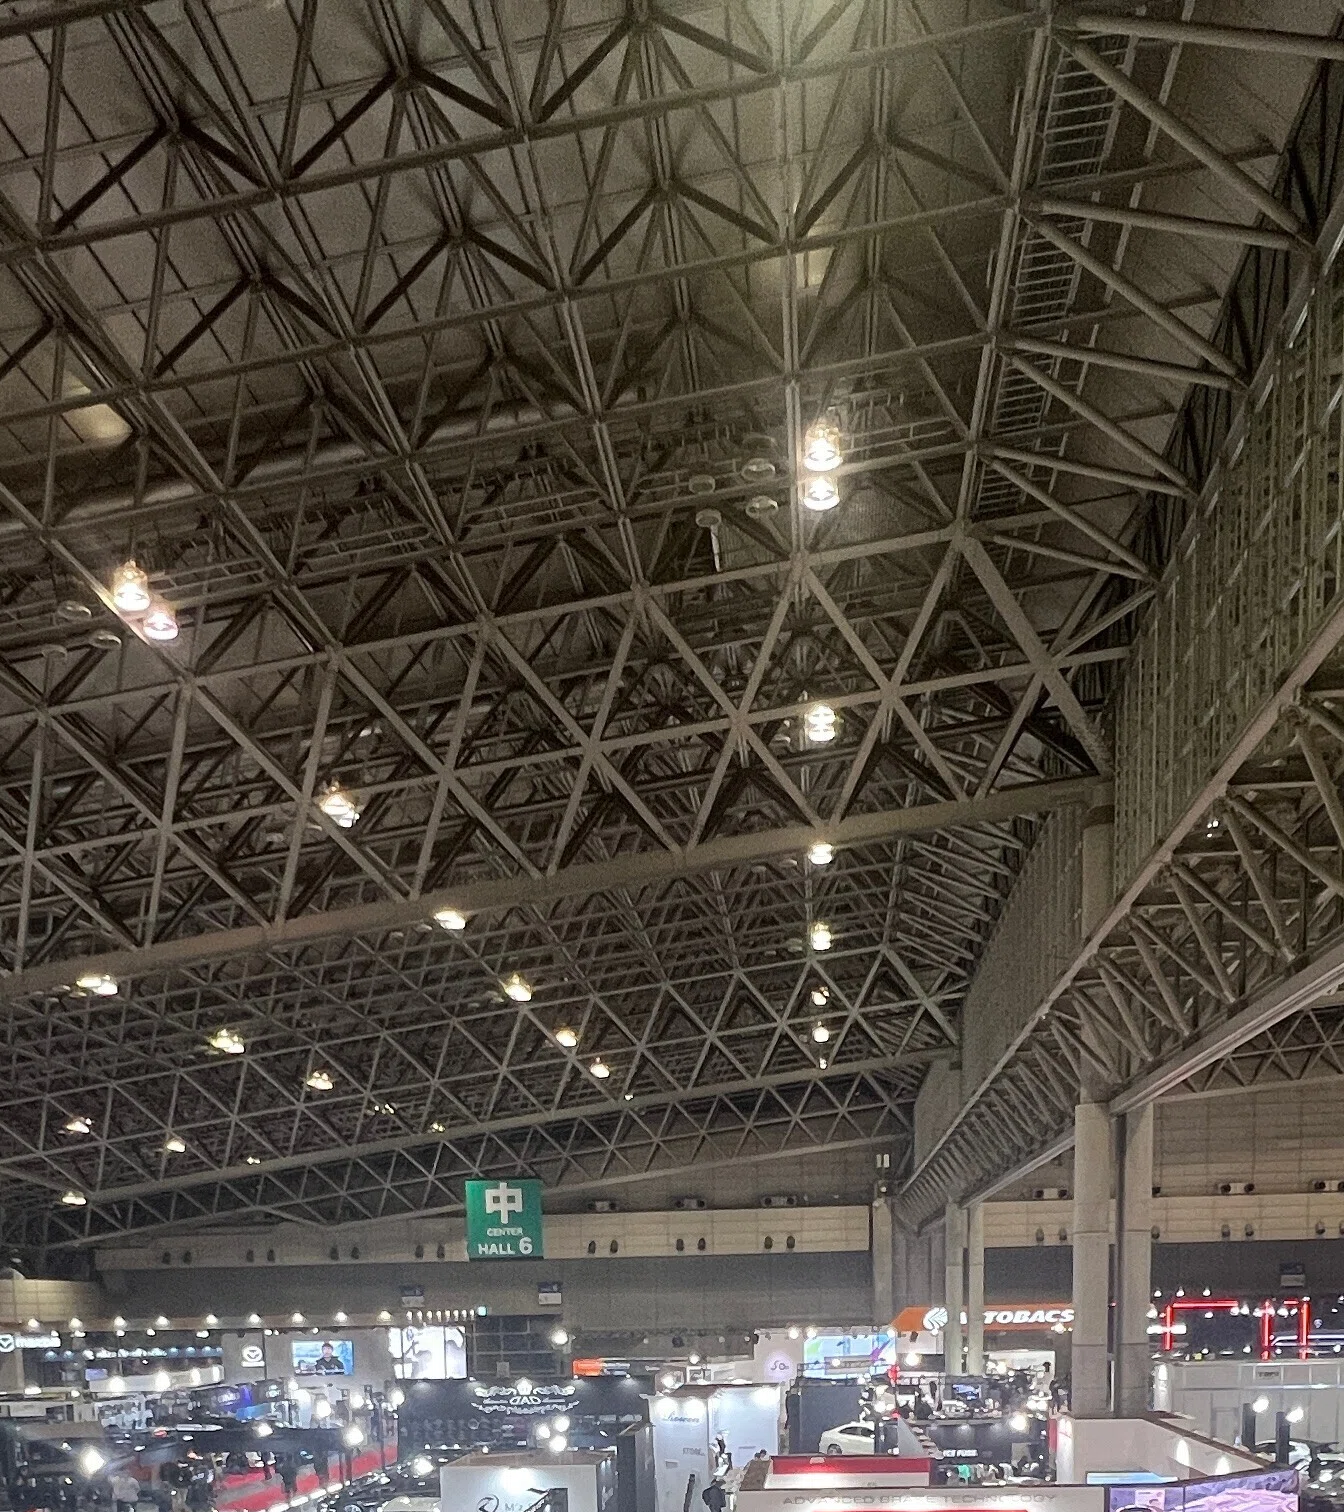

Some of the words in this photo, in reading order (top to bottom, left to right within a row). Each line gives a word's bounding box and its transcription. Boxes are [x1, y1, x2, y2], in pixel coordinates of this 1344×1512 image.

[485, 1182, 523, 1224] 中
[478, 1243, 516, 1255] HALL
[519, 1236, 533, 1255] 6
[959, 1309, 1075, 1325] TOBACS
